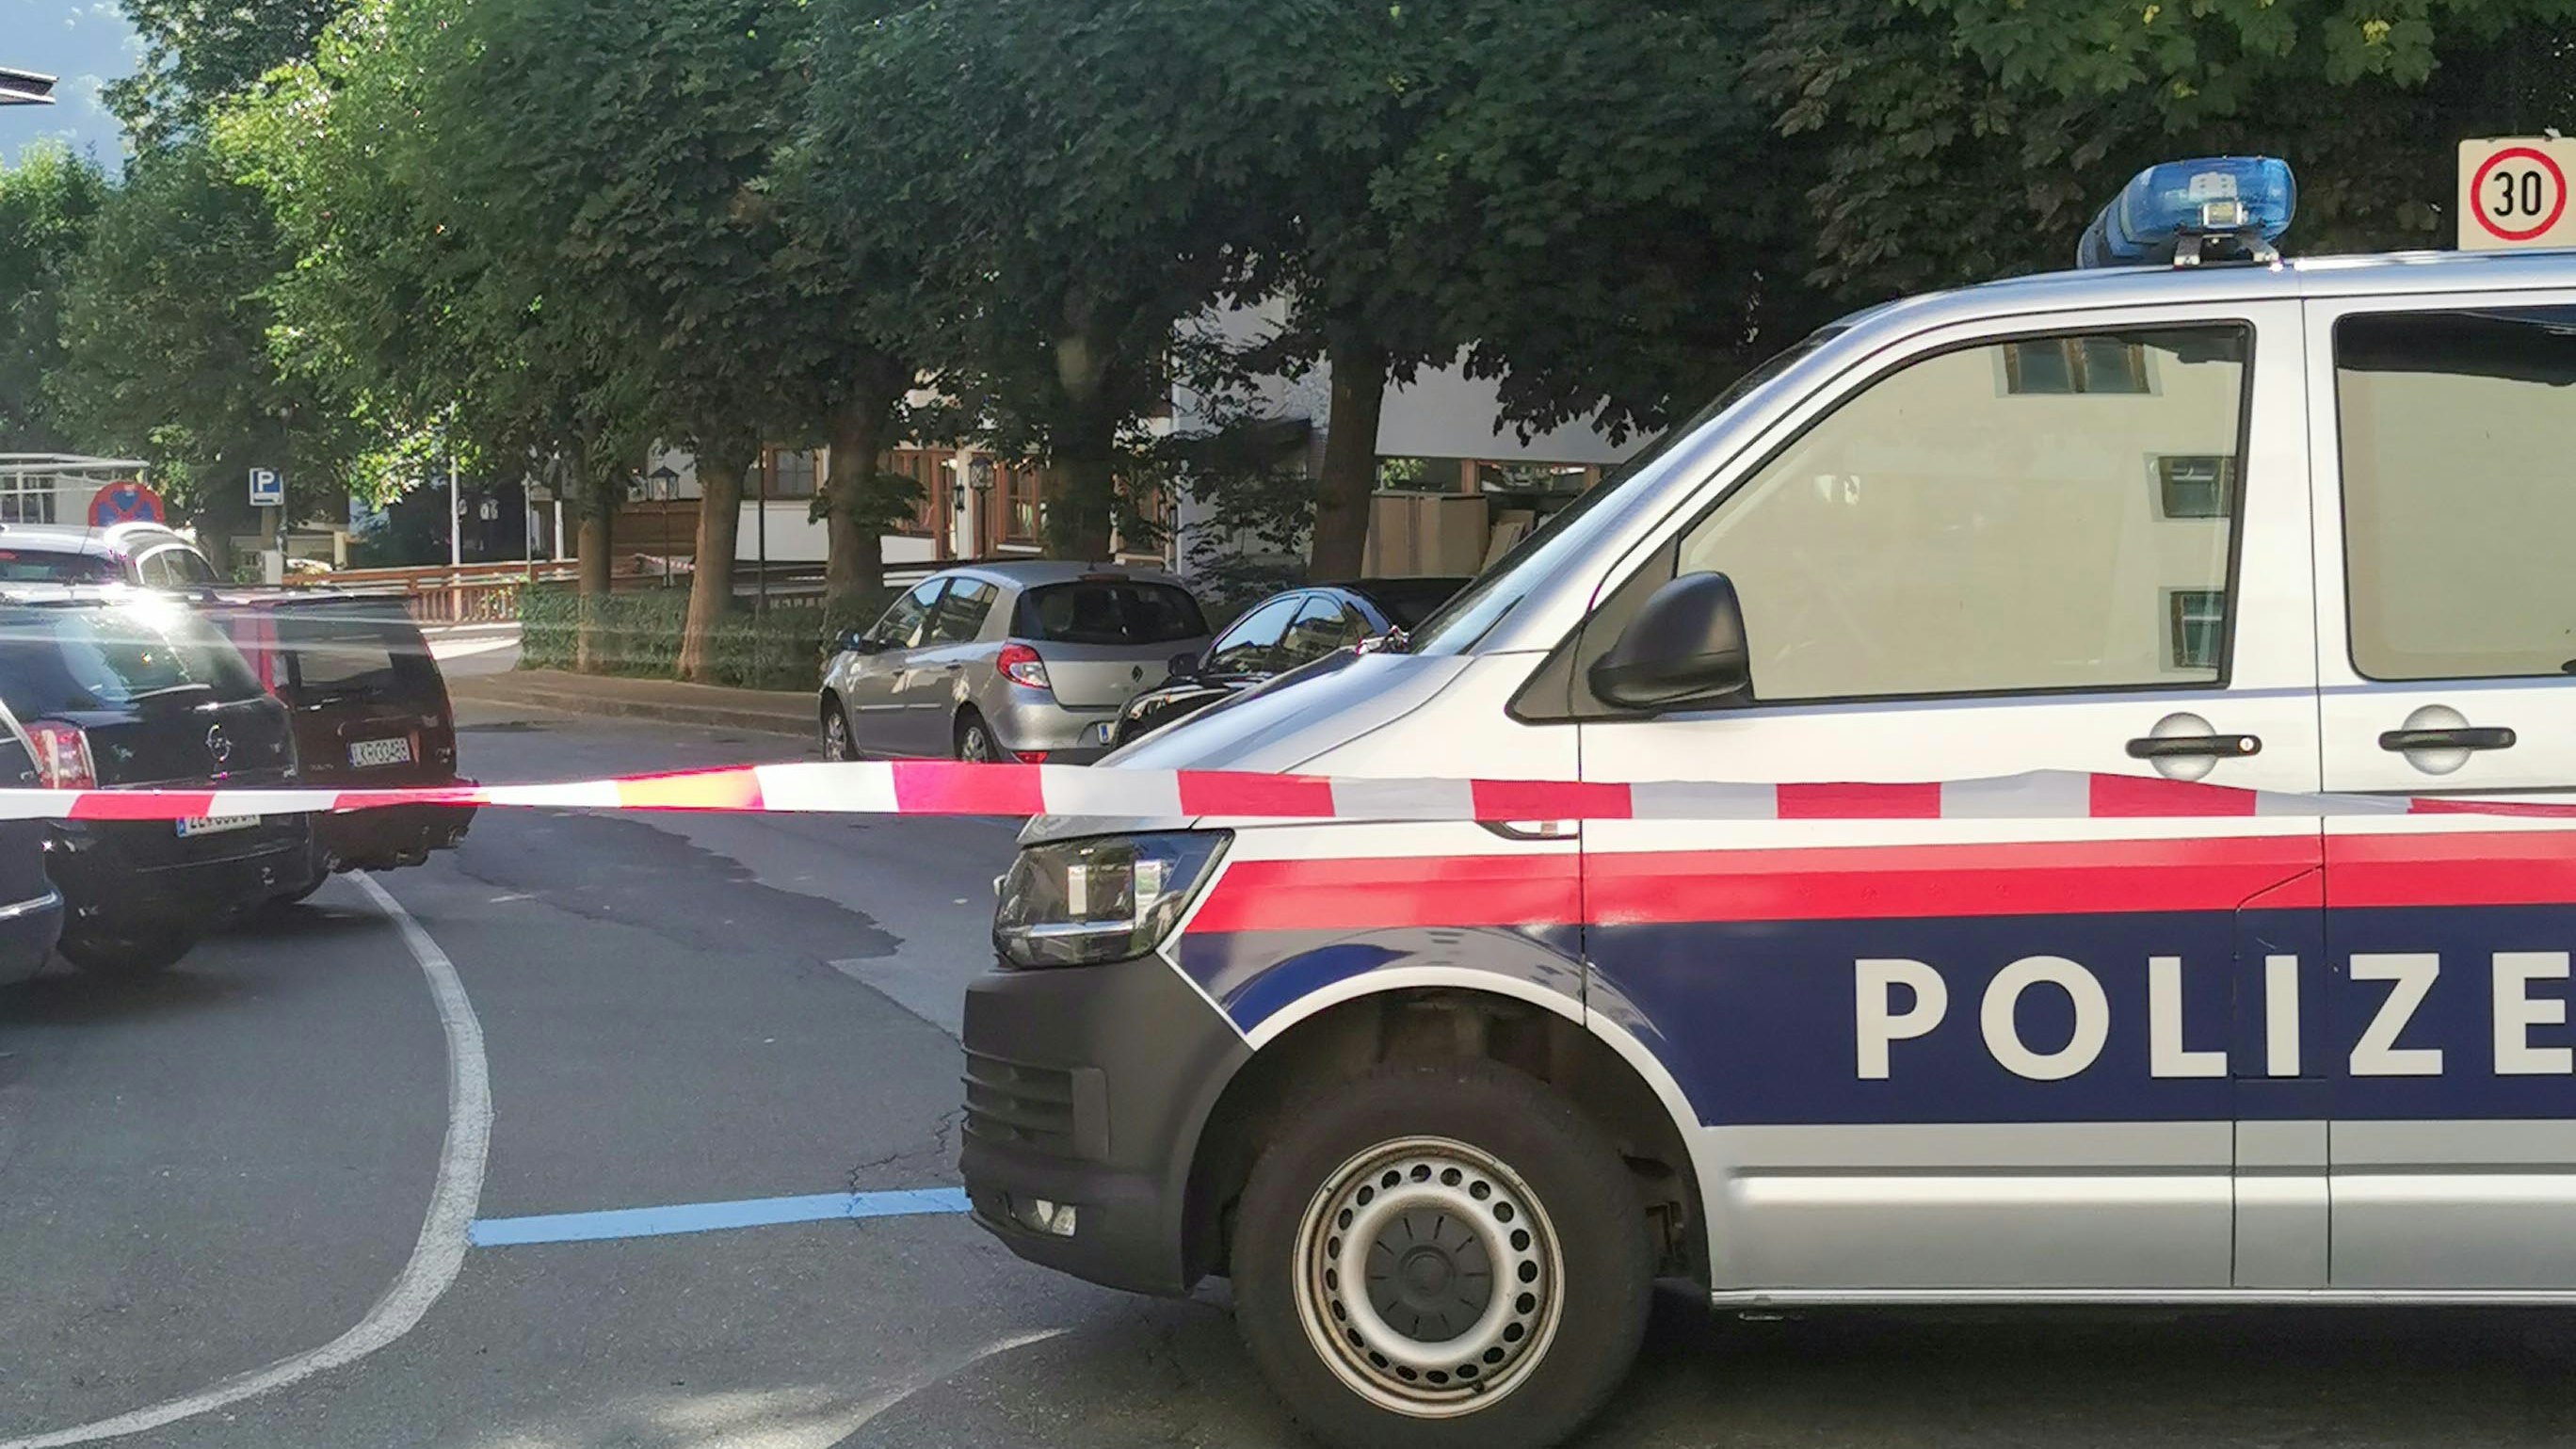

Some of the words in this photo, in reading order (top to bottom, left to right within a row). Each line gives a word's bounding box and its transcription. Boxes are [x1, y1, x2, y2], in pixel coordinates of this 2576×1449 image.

[2493, 170, 2541, 217] 30
[258, 471, 275, 491] P
[1854, 951, 2575, 1080] POLIZE
